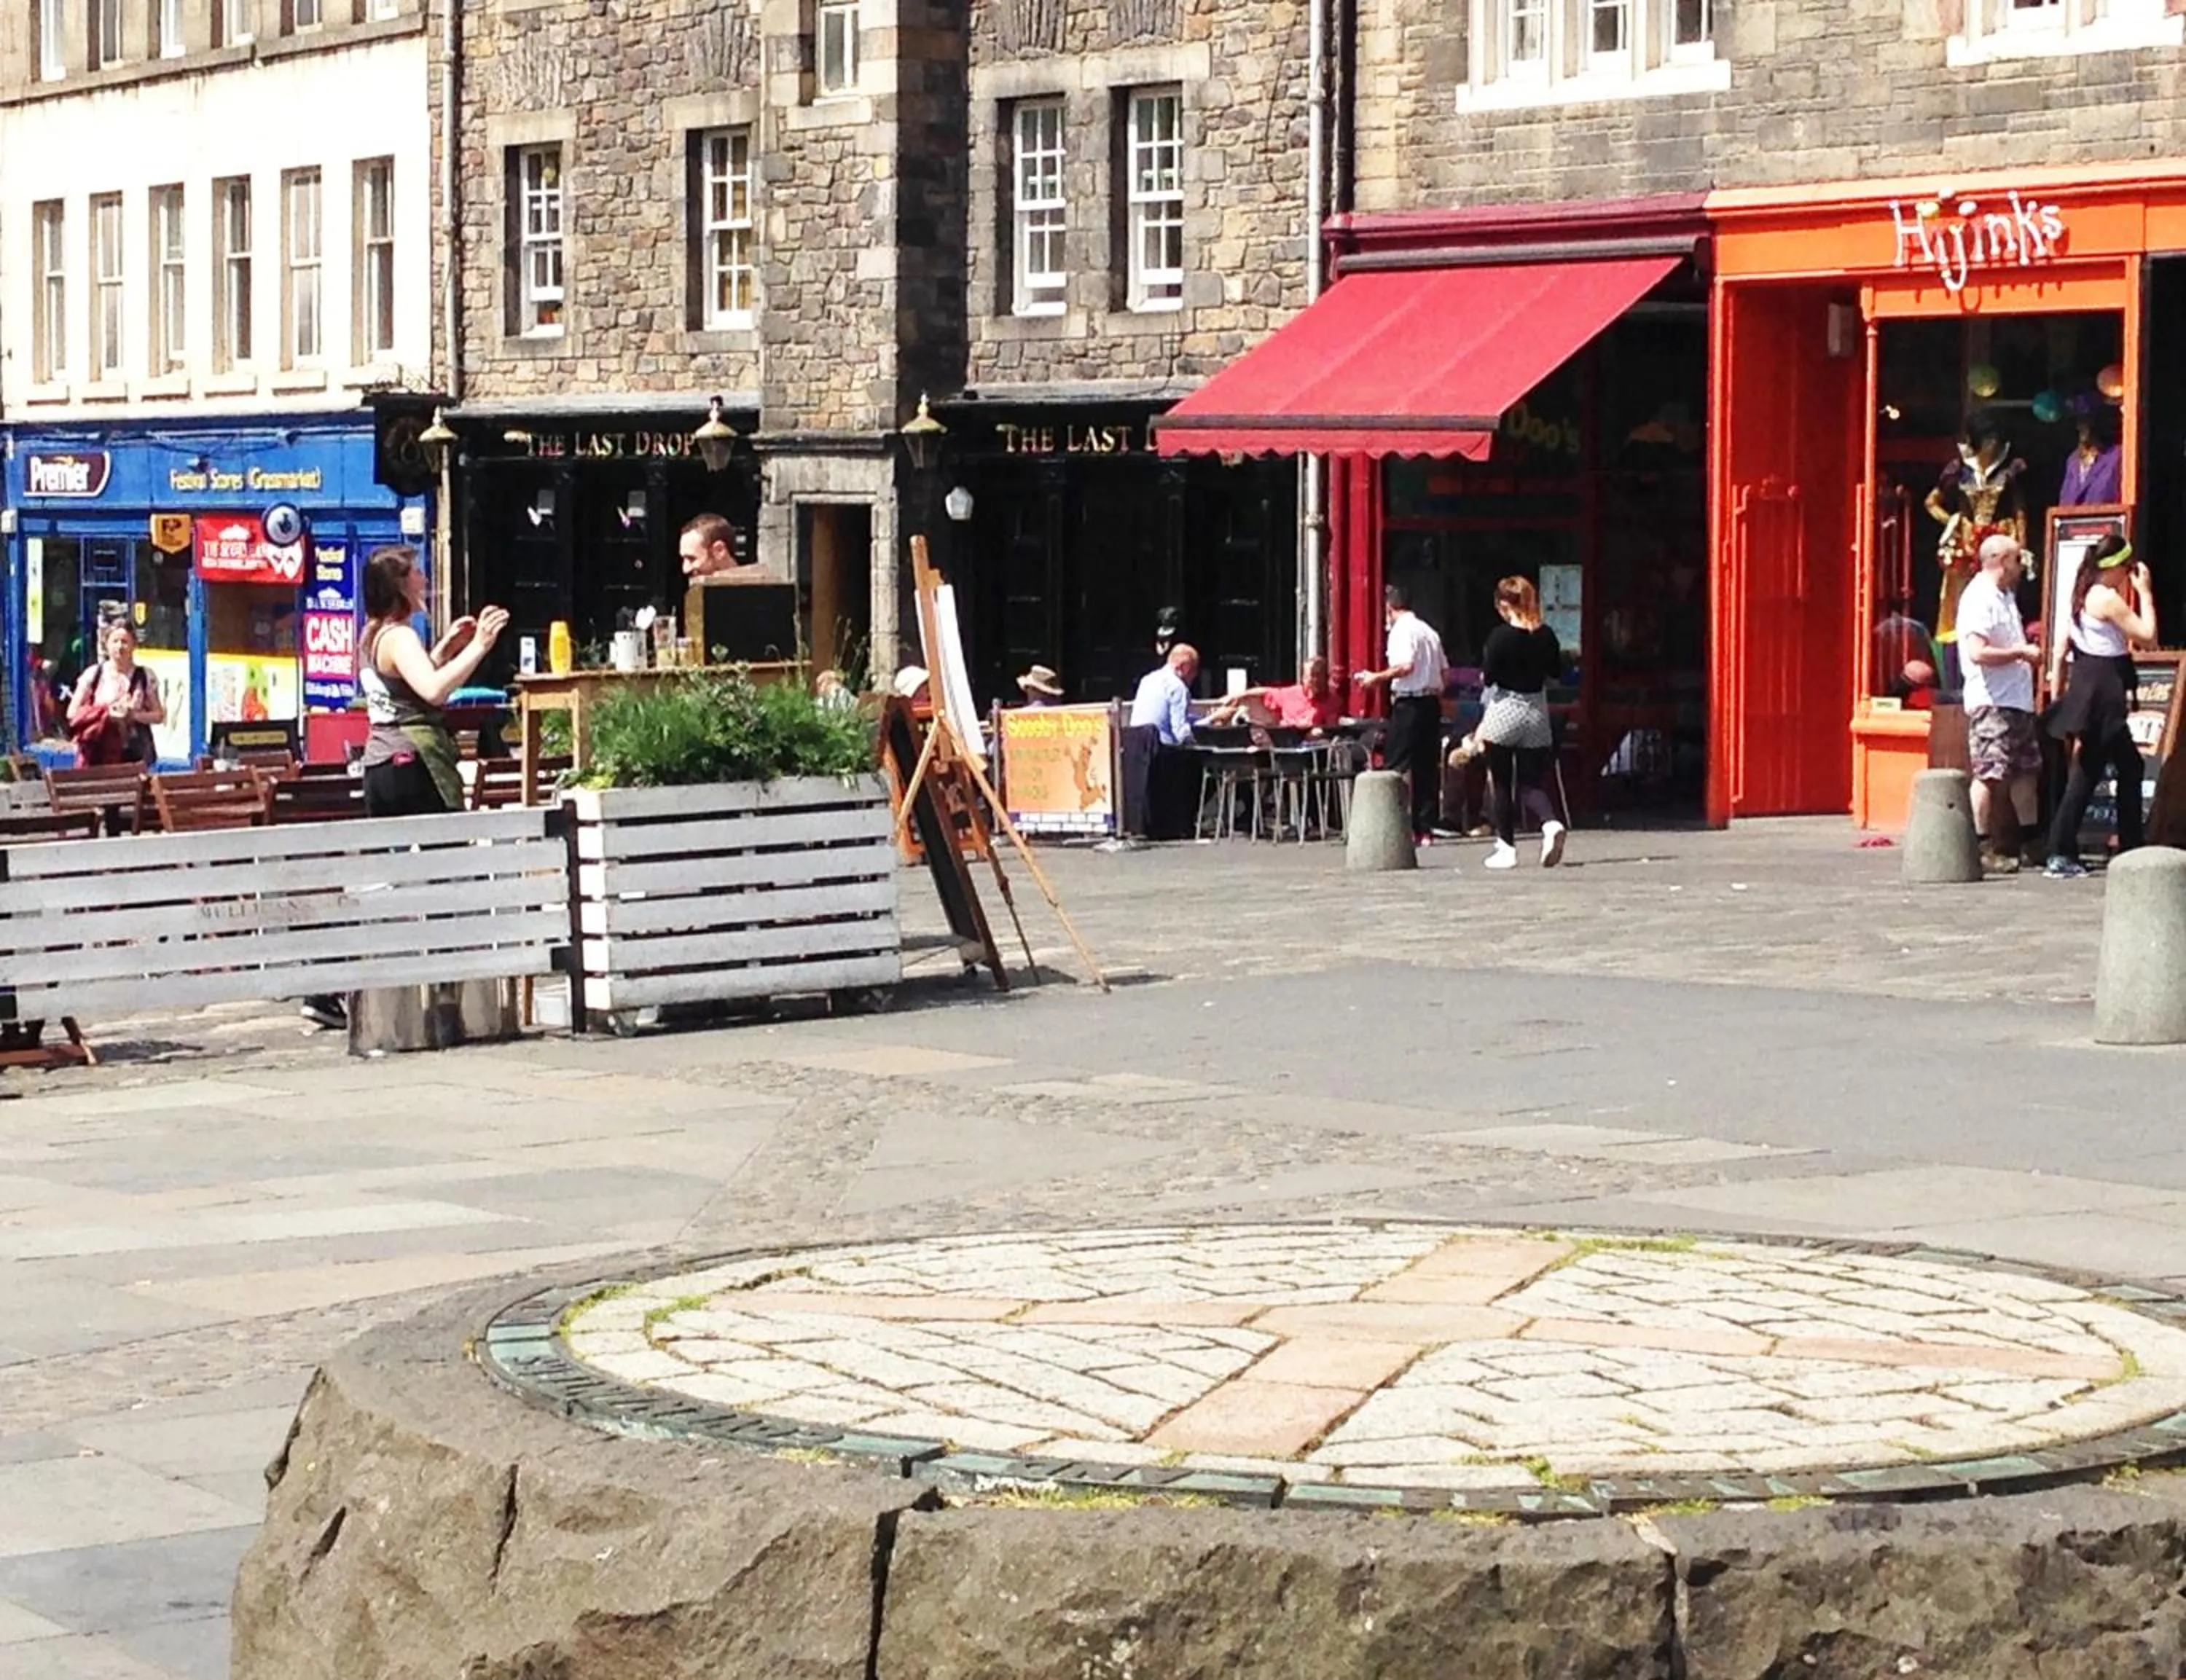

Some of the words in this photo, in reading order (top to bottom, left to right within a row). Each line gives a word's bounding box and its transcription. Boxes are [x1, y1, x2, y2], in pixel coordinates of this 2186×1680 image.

[1889, 187, 2064, 291] Hijinks
[522, 431, 566, 457] THE
[574, 431, 627, 457] LAST
[634, 430, 695, 457] DROP
[997, 423, 1055, 452] THE
[1067, 424, 1132, 452] LAST
[306, 616, 353, 653] CASH
